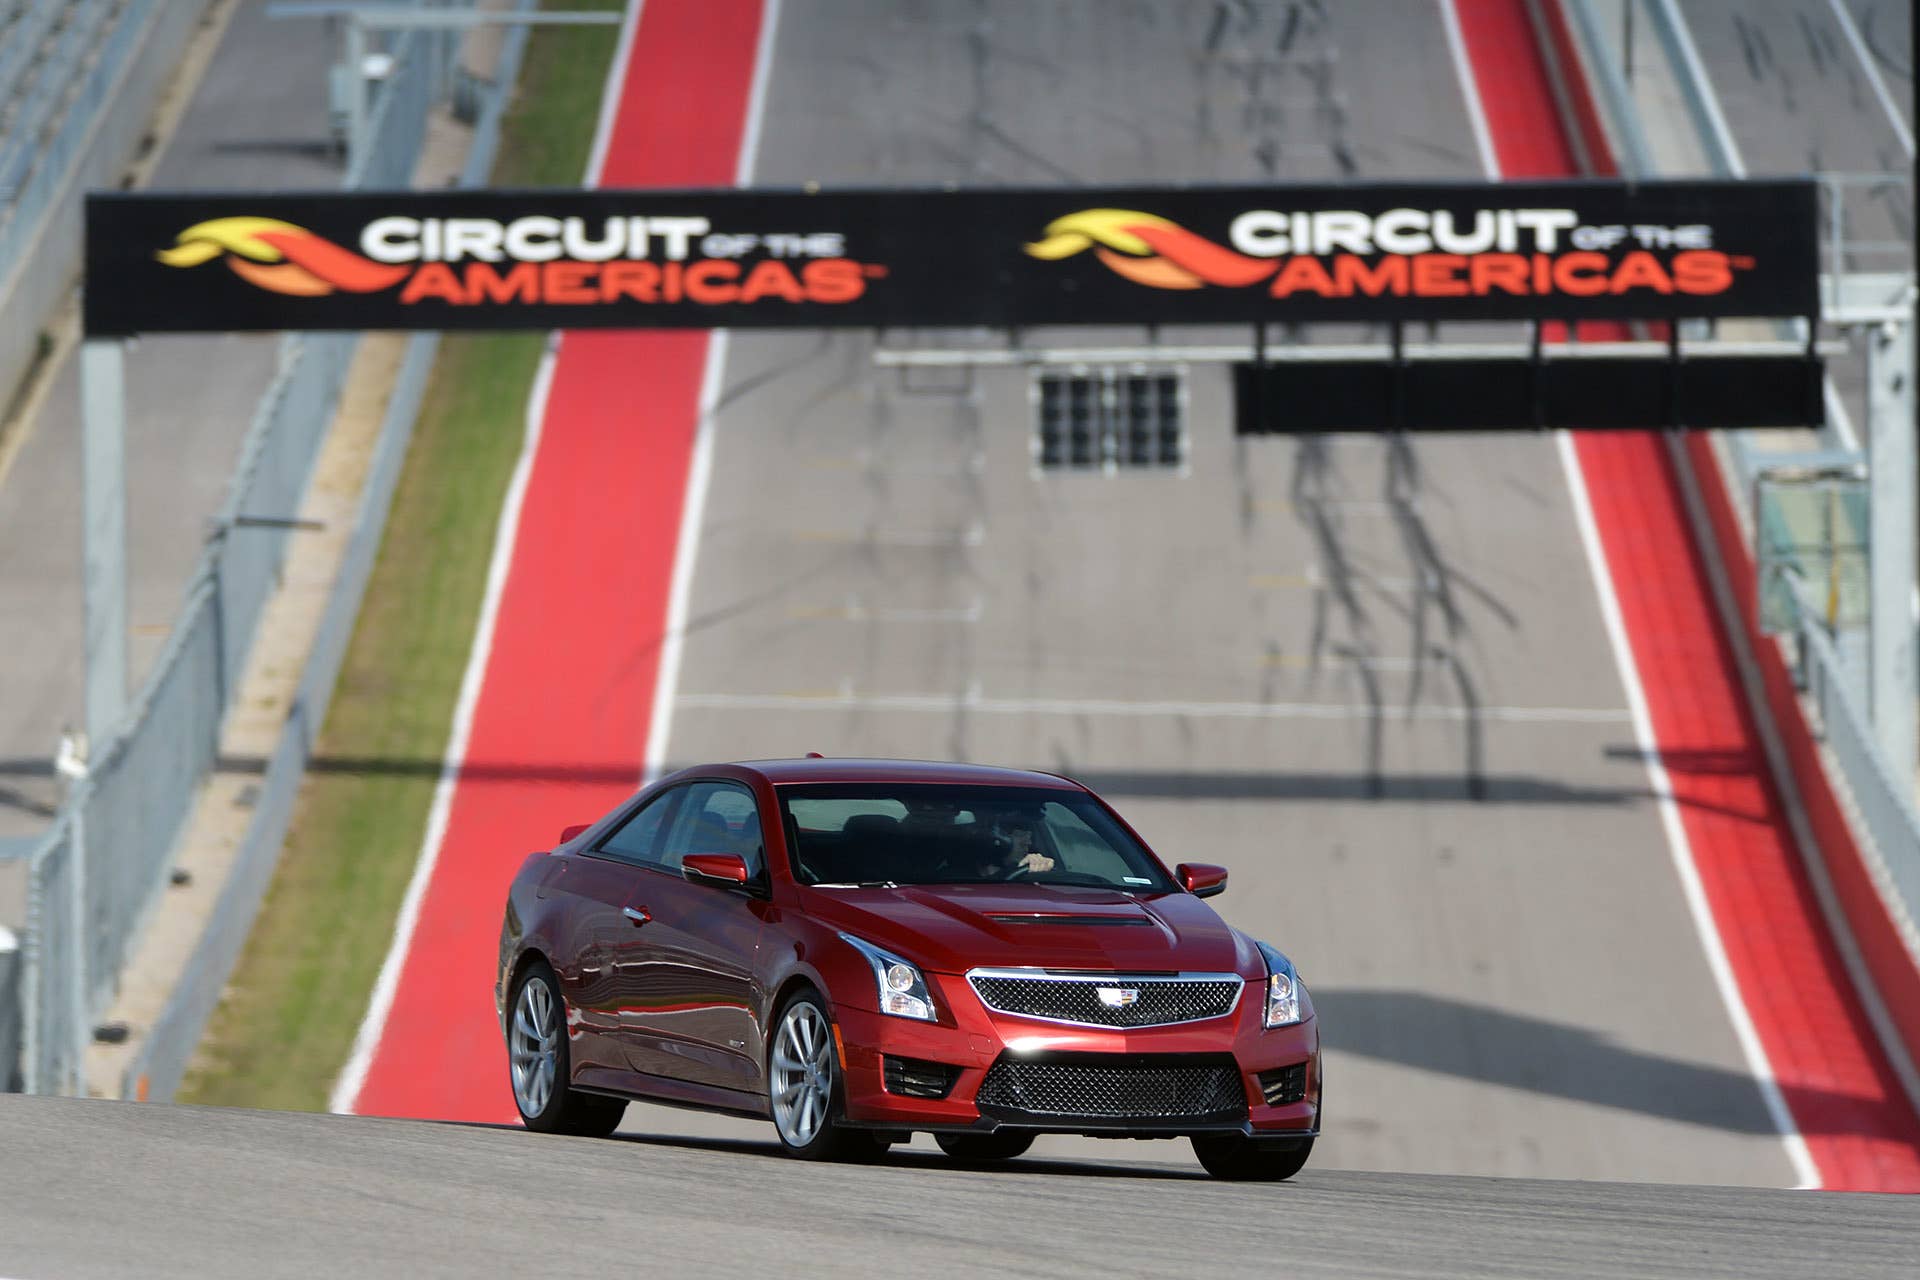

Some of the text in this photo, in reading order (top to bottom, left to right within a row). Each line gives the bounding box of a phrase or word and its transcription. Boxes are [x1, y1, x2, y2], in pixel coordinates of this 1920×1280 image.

[360, 216, 845, 263] CIRCUIT OF THE
[1229, 208, 1711, 257] CIRCUIT OF THE
[400, 258, 866, 305] AMERICAS
[1270, 250, 1734, 298] AMERICAS
